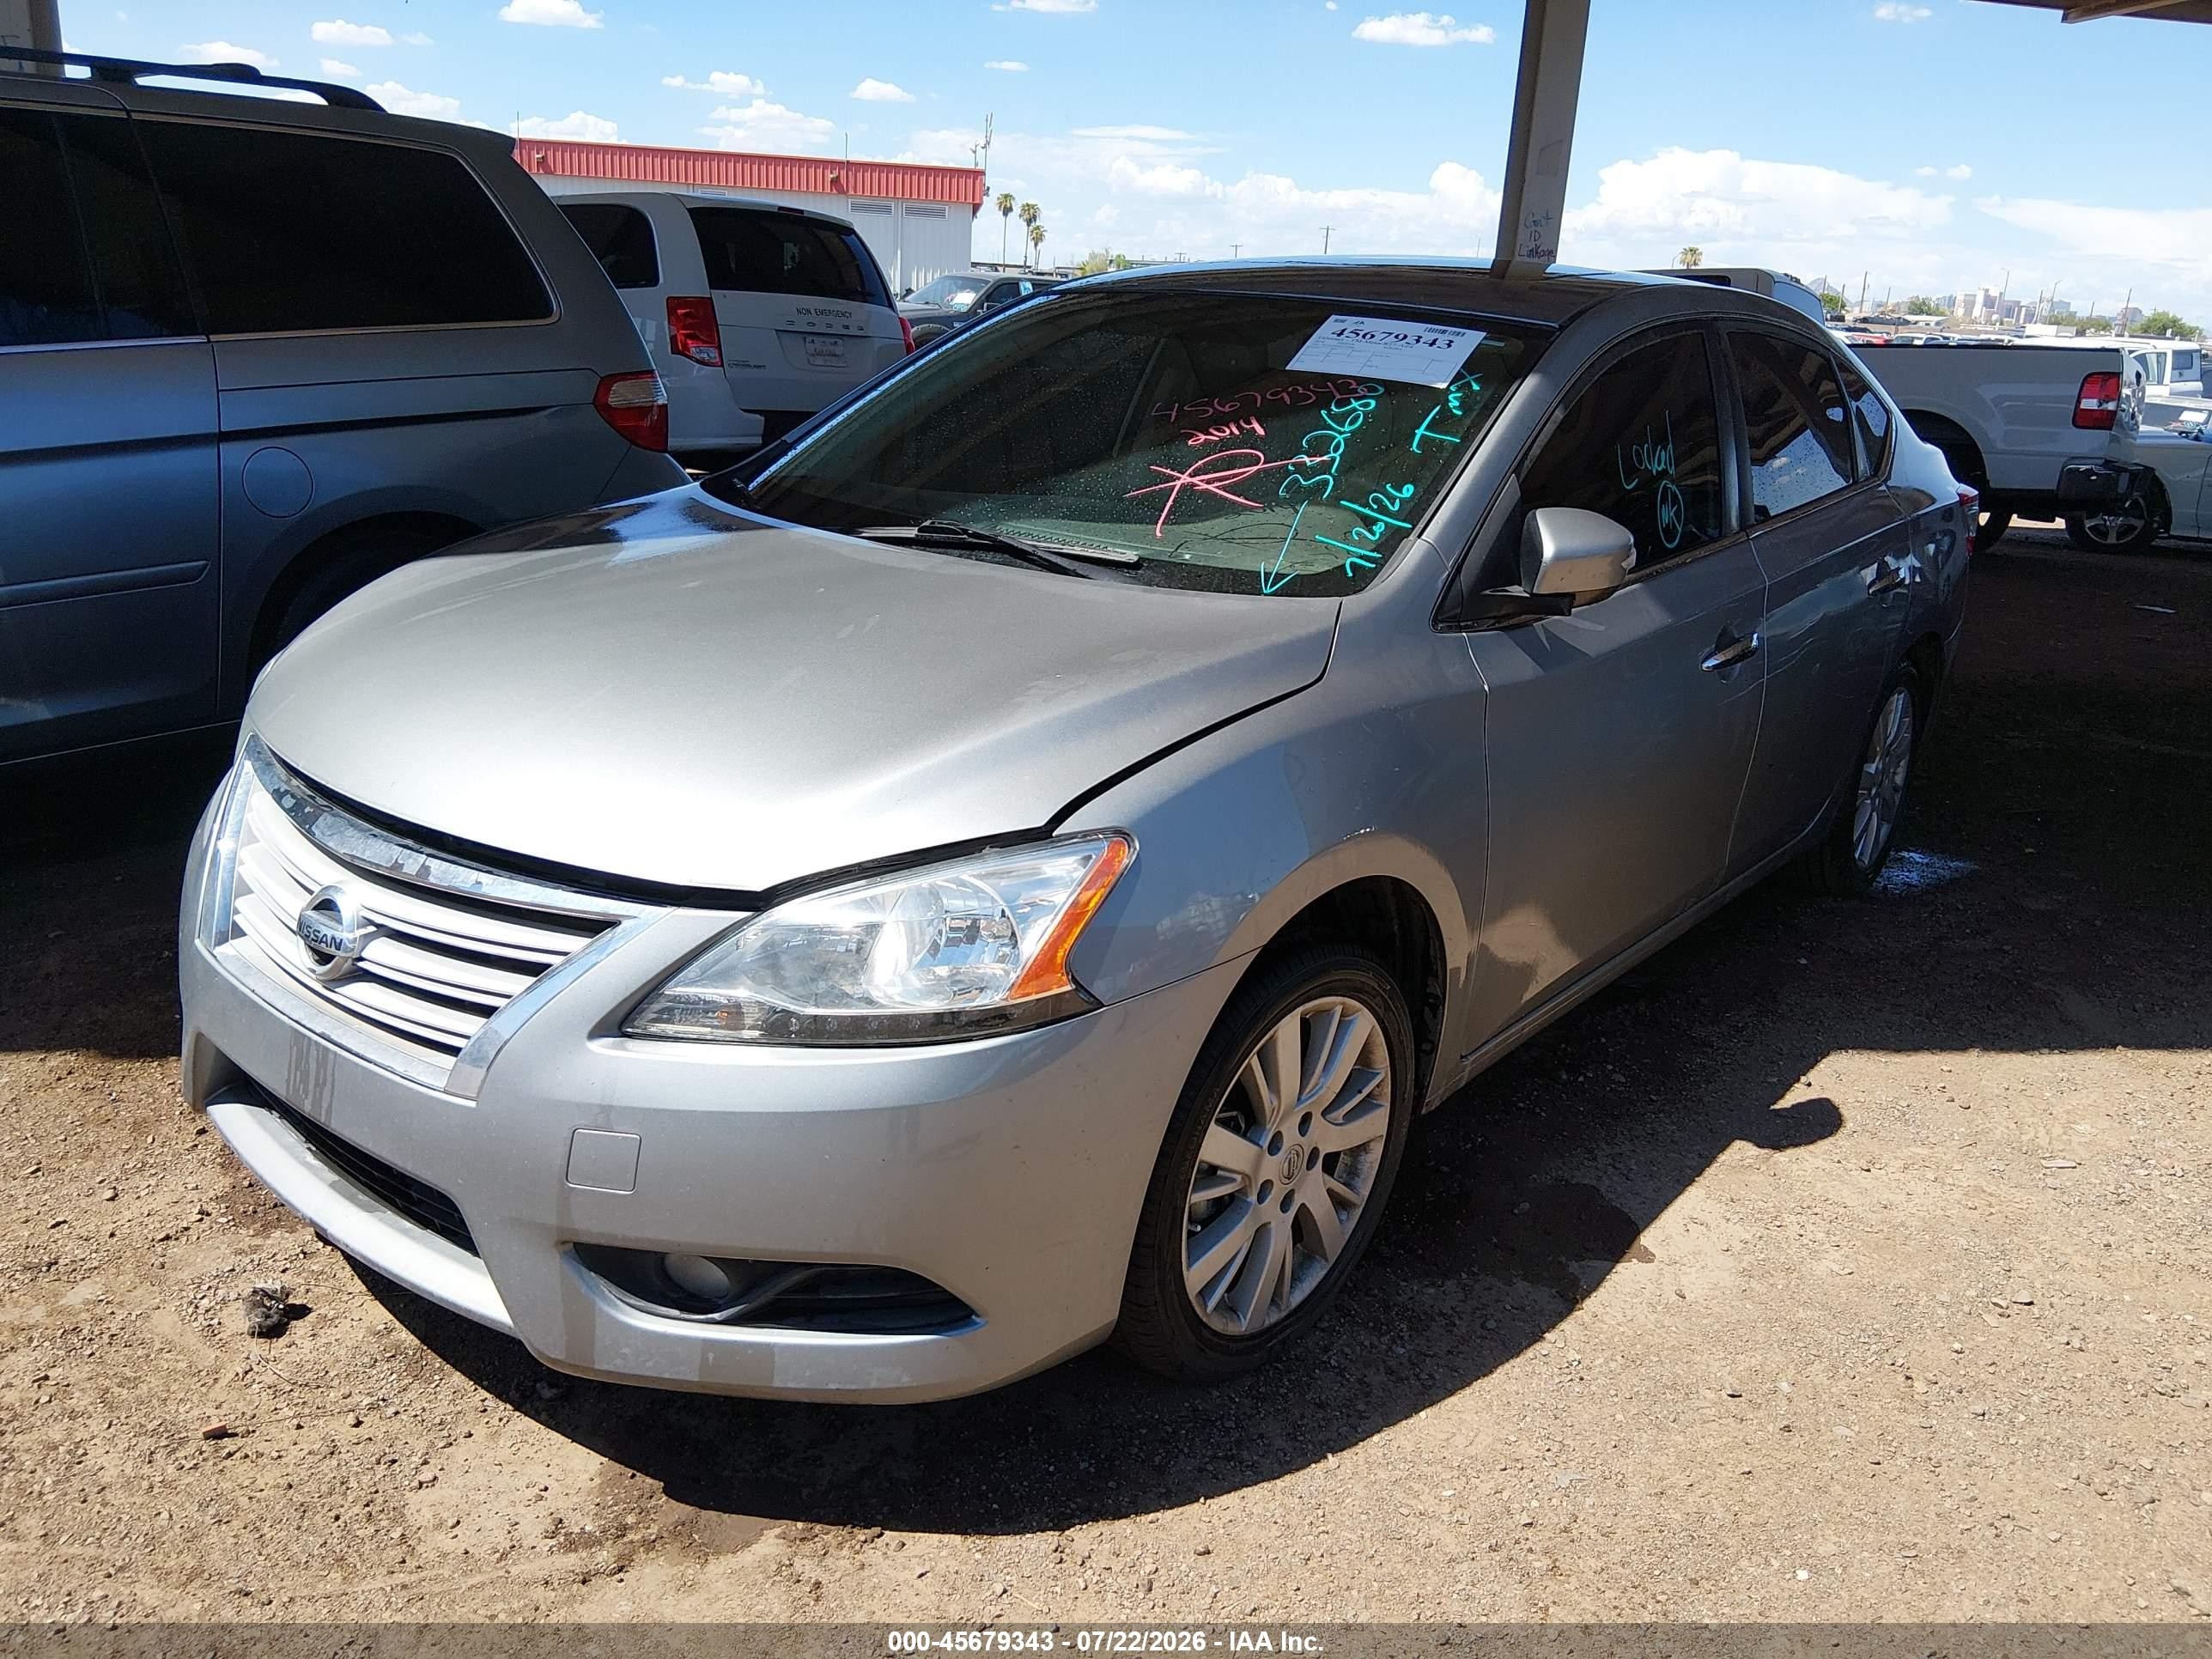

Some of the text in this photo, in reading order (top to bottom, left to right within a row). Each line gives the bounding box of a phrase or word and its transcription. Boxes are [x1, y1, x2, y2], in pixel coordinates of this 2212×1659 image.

[795, 307, 853, 319] NON EMERGENCY
[1330, 326, 1455, 349] 45679343
[1149, 378, 1369, 422] 45679343
[1180, 415, 1266, 446] 2014
[297, 919, 343, 951] NISSAN
